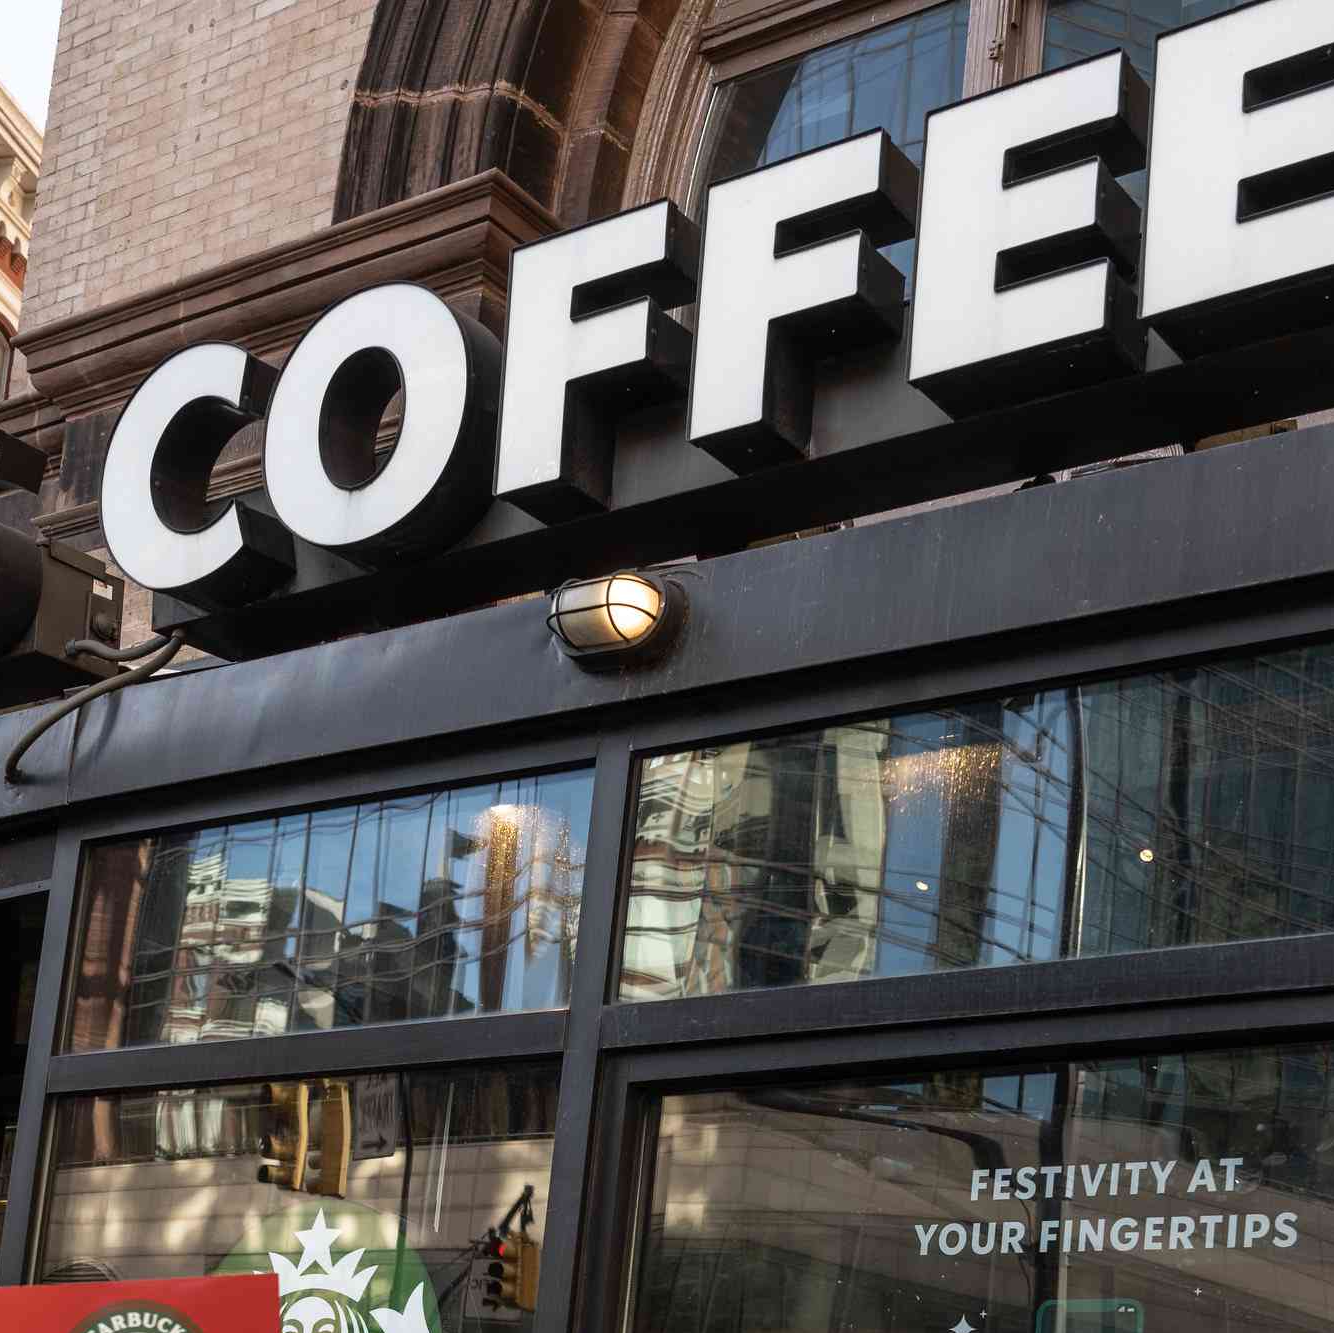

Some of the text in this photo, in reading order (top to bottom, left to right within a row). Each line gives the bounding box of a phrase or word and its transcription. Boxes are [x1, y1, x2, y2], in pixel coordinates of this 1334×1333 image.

[969, 1157, 1245, 1201] FESTIVITY AT
[913, 1212, 1300, 1256] YOUR FINGERTIPS
